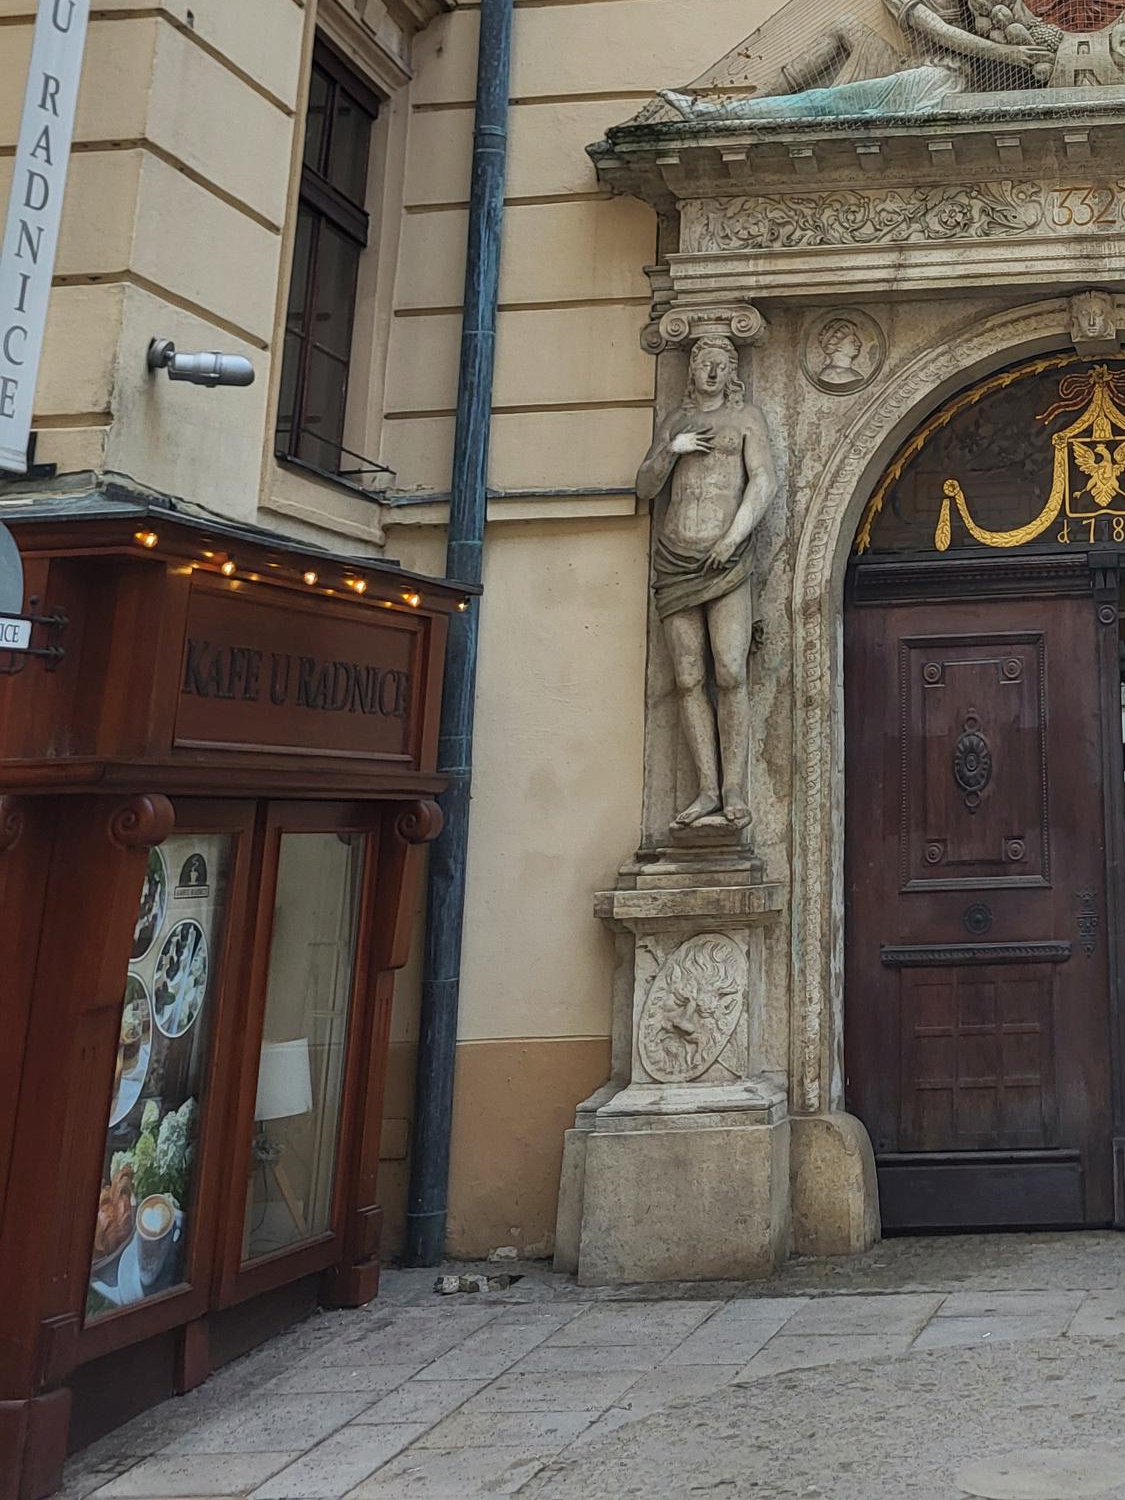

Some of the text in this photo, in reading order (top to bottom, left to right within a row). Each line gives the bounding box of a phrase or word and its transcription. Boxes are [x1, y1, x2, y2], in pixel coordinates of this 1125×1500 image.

[0, 71, 61, 419] RADNICE
[1050, 185, 1117, 227] 332
[181, 637, 410, 719] KAFE U RADNICE
